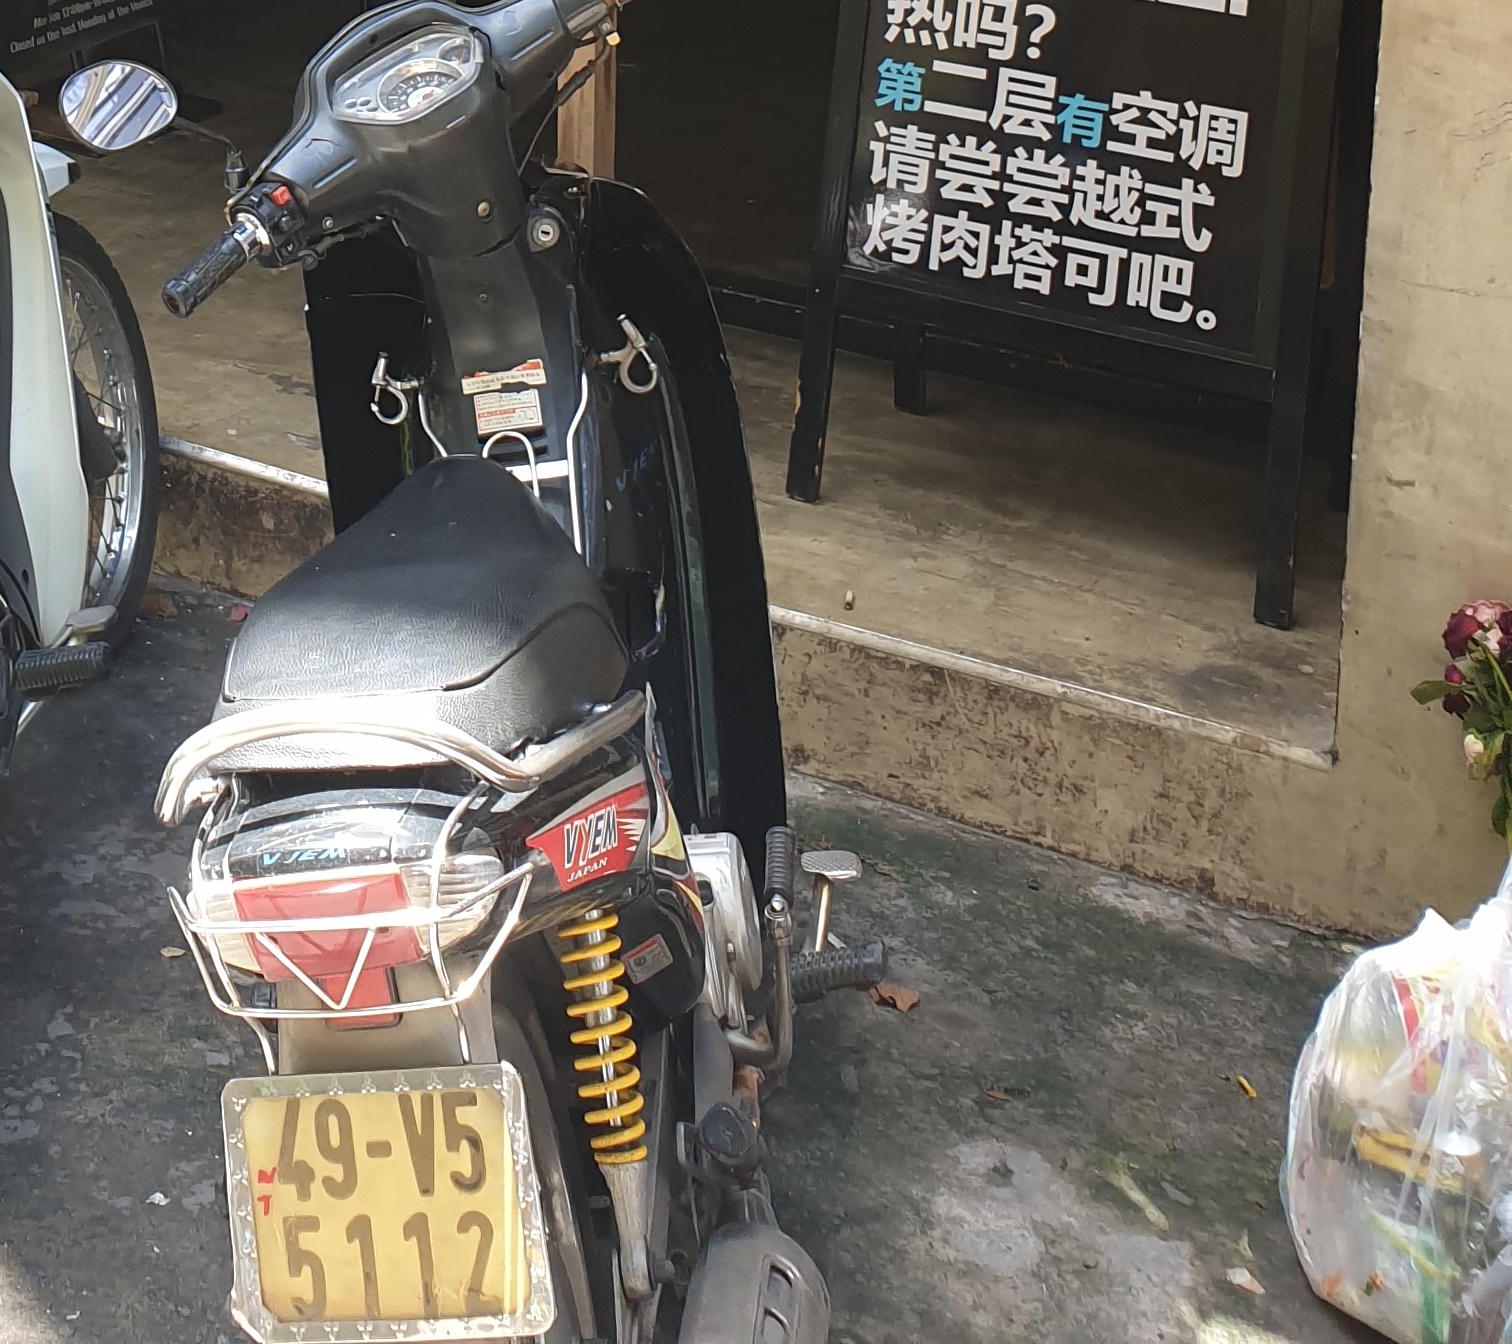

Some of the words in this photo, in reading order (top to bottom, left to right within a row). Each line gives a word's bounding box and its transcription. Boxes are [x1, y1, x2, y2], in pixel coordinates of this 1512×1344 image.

[873, 58, 1249, 178] 第二层有空调
[868, 120, 1216, 253] 请尝尝越式
[861, 194, 1218, 331] 烤肉塔可吧。
[566, 856, 609, 883] JAPAN
[277, 1088, 488, 1202] 49-V5
[287, 1209, 496, 1318] 5112
